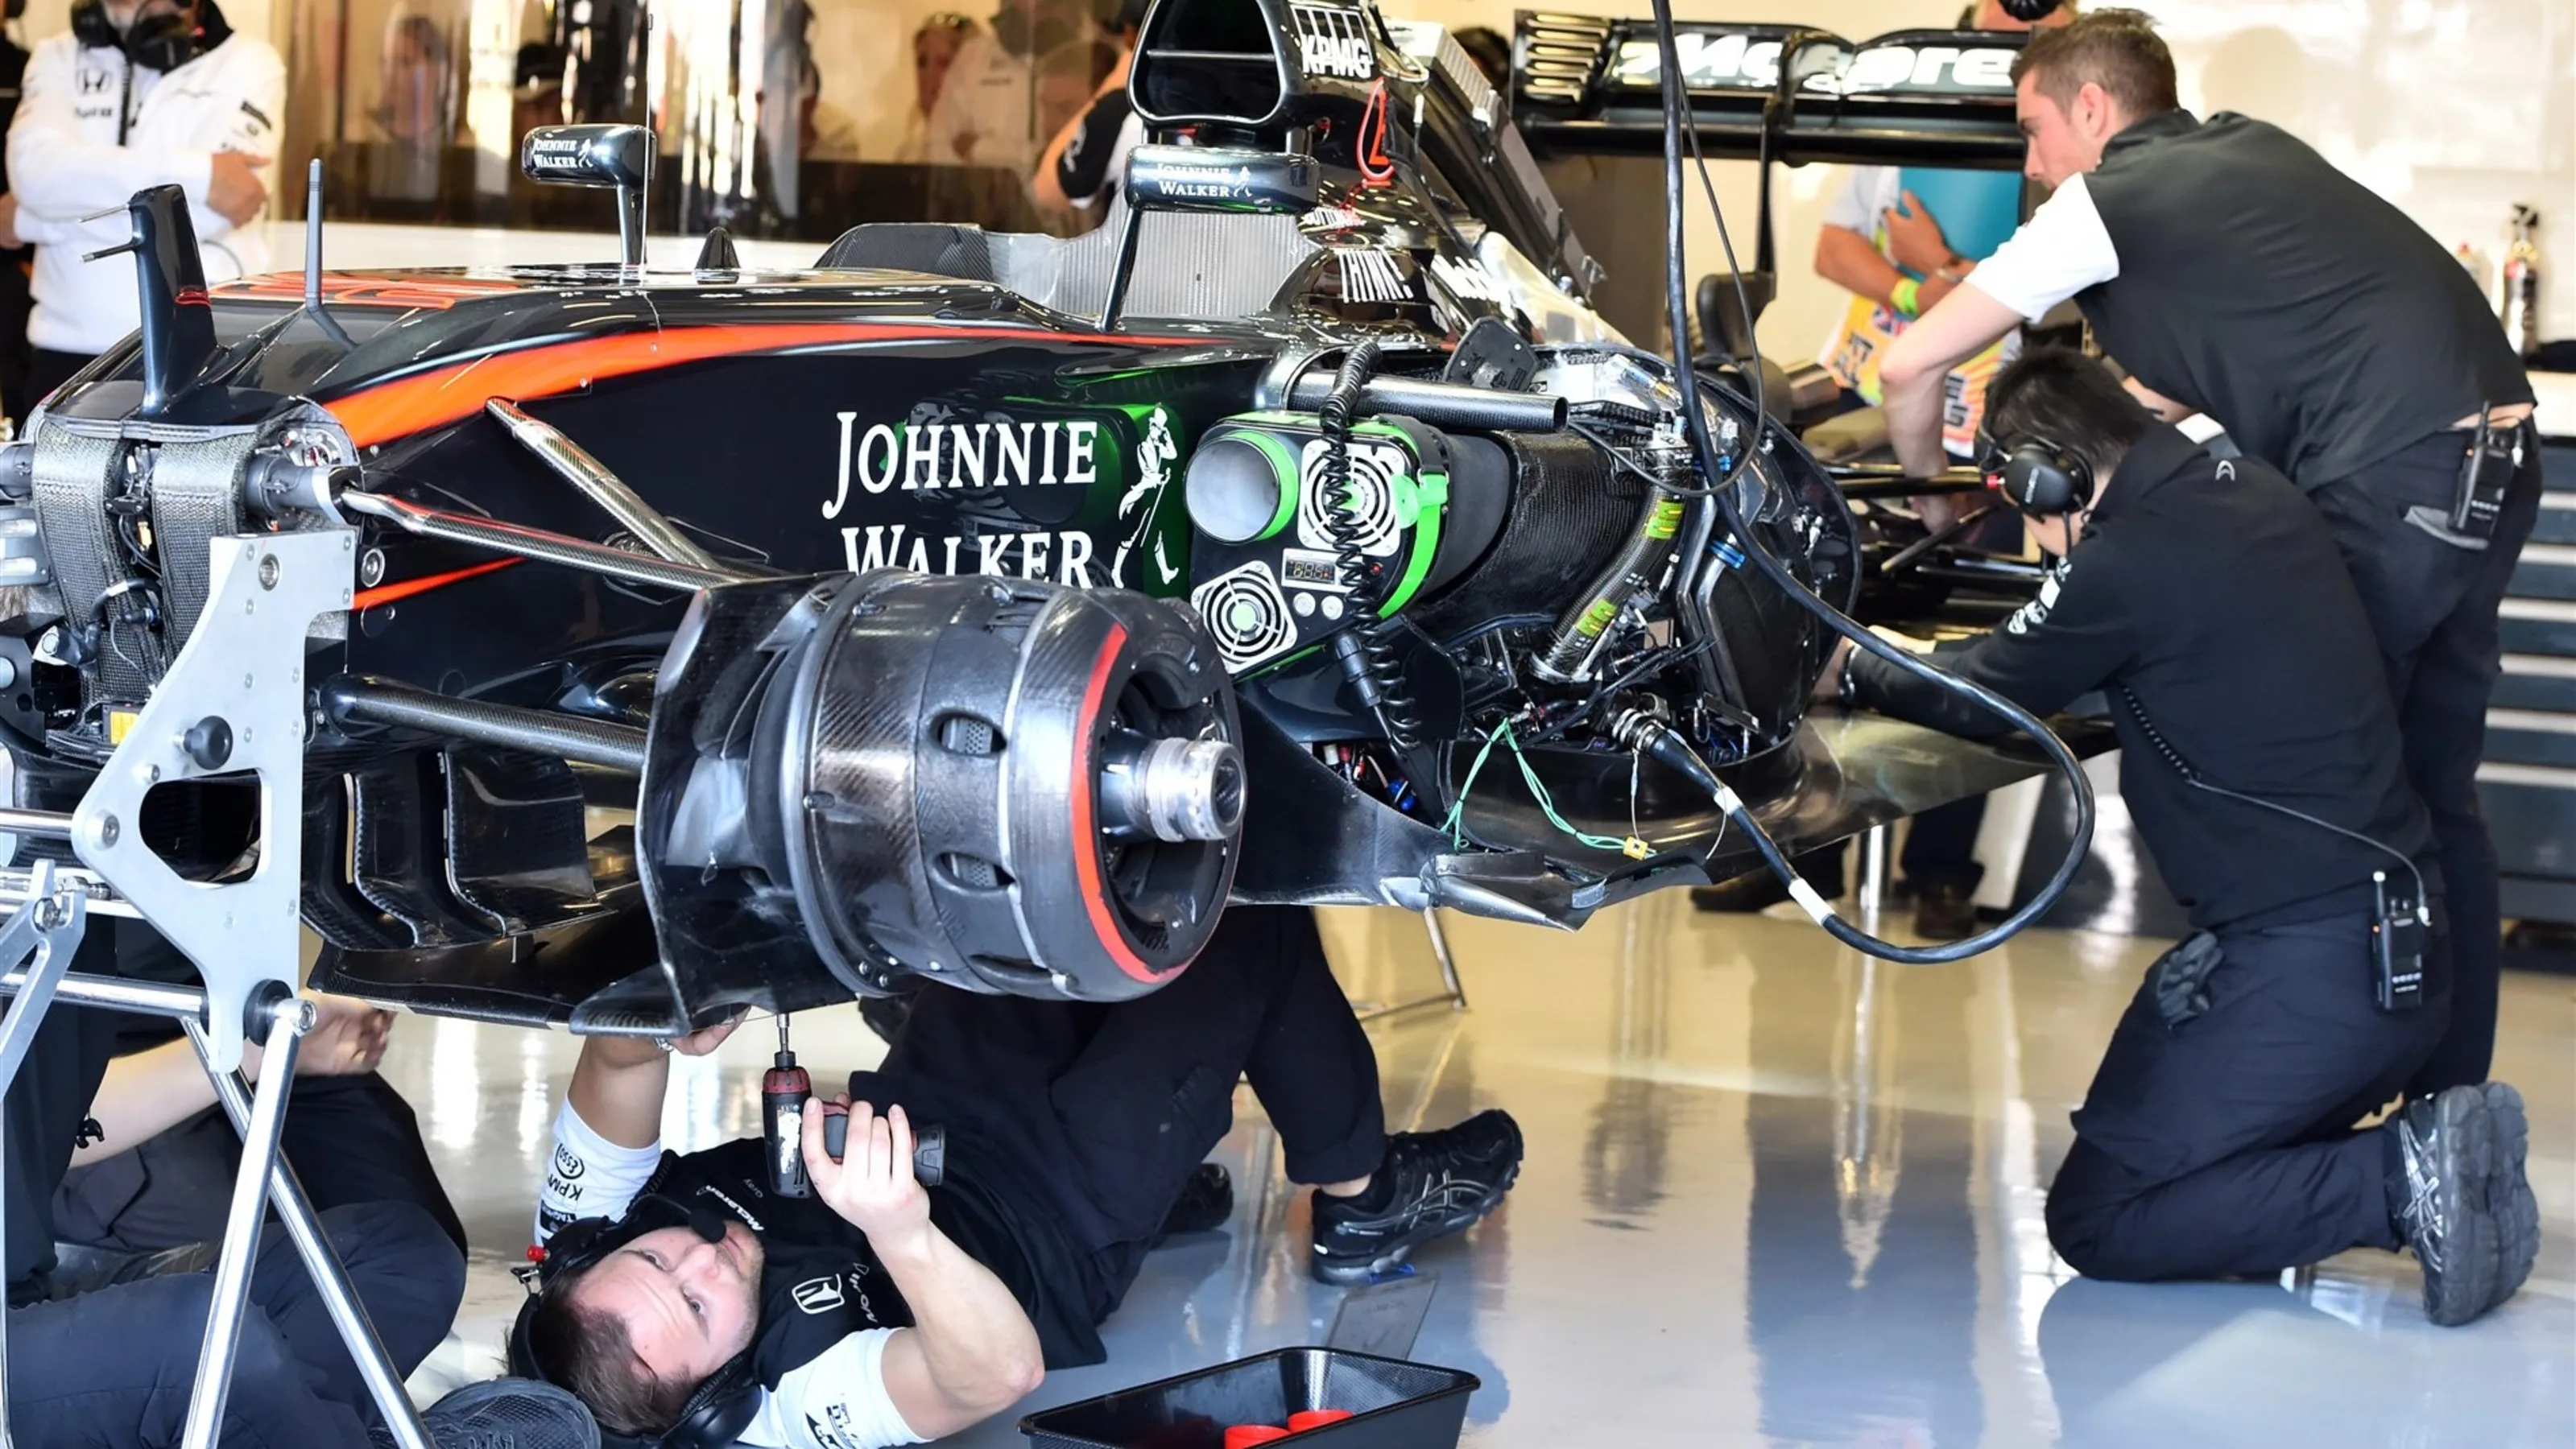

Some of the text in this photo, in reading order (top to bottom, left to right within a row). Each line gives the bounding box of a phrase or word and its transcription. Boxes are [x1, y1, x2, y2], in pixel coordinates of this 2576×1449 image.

[1301, 34, 1372, 78] KPMG
[531, 138, 577, 155] JOHNNIE
[534, 154, 577, 168] WALKER
[1159, 180, 1230, 197] WALKER
[1334, 244, 1414, 303] THINK!
[822, 411, 1098, 519] JOHNNIE
[548, 1174, 583, 1201] KPM
